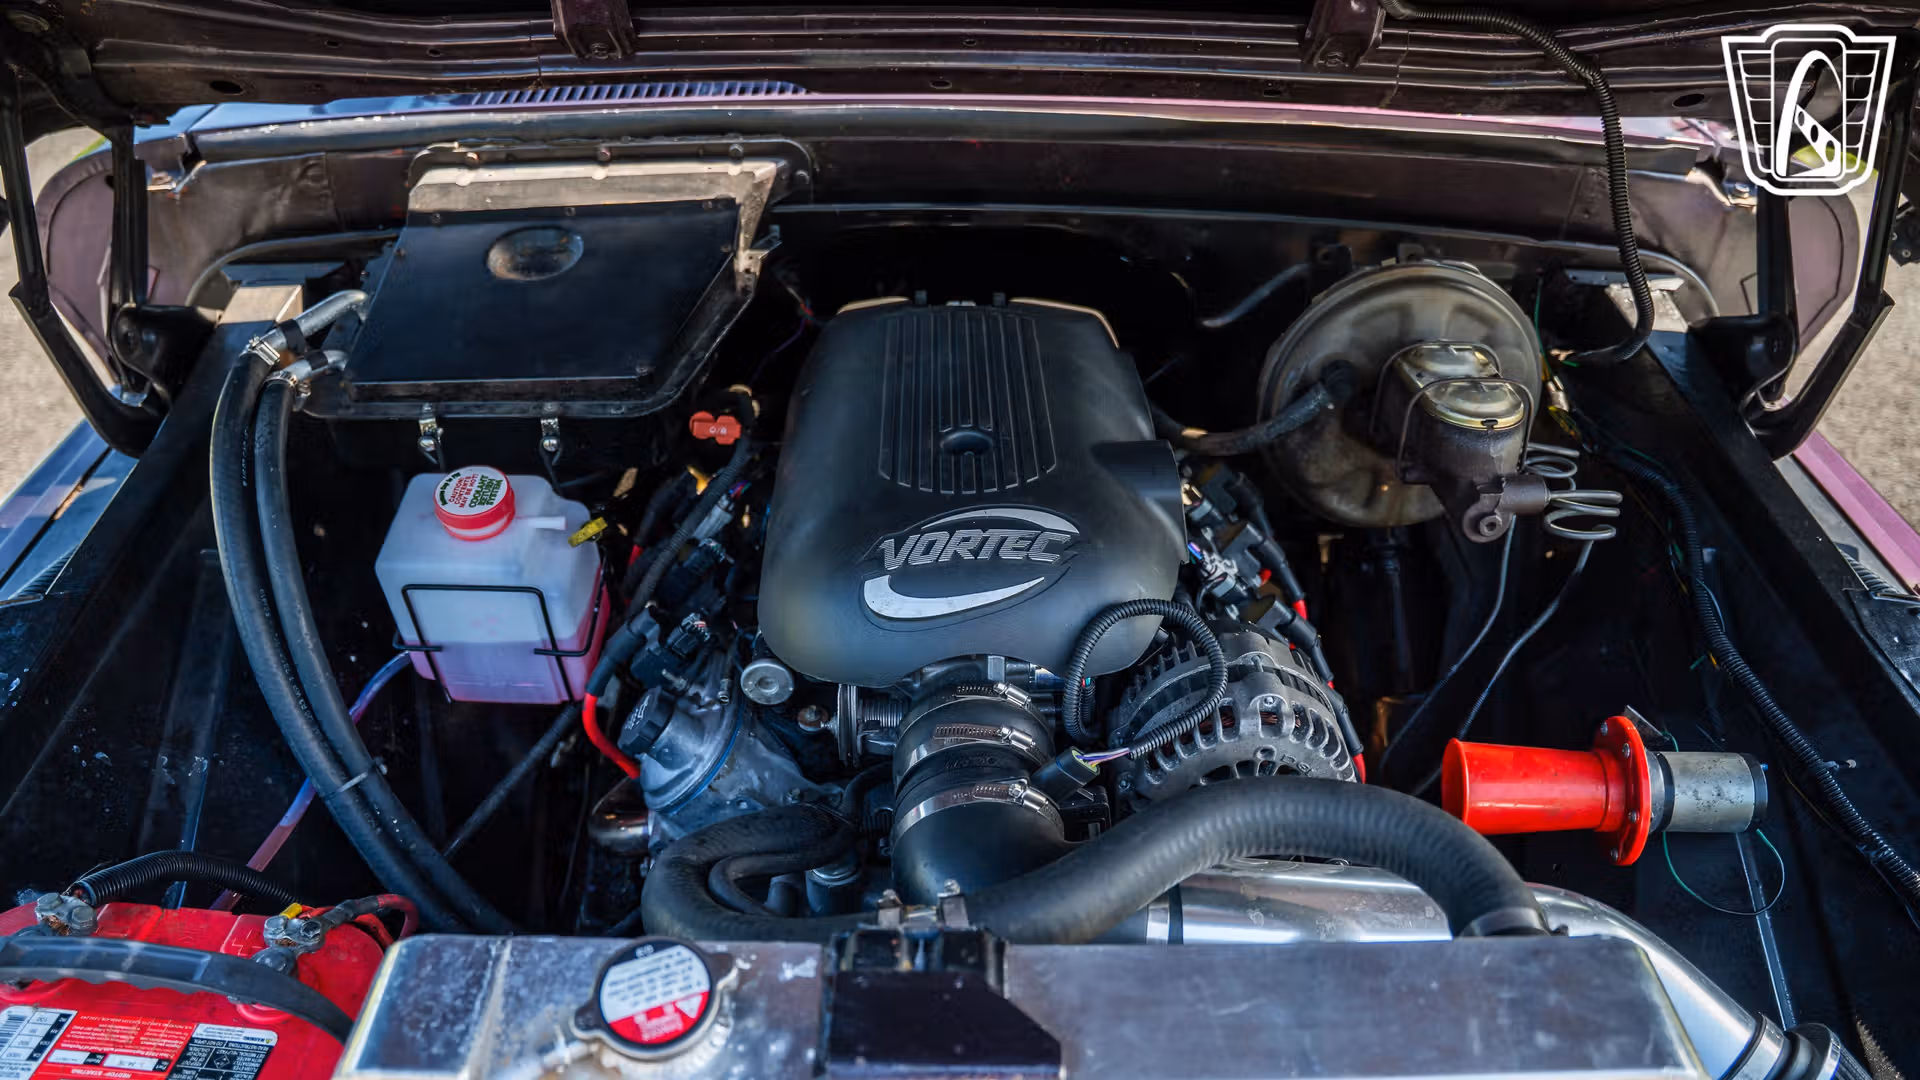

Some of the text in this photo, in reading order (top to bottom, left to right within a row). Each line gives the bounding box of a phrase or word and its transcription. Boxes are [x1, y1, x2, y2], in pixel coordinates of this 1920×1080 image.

[454, 476, 472, 505] CONTENTS
[459, 496, 469, 508] MAY
[465, 487, 473, 496] BE
[468, 474, 489, 508] COOLANT
[485, 480, 504, 506] SYSTEM
[879, 529, 1071, 571] VORTEC
